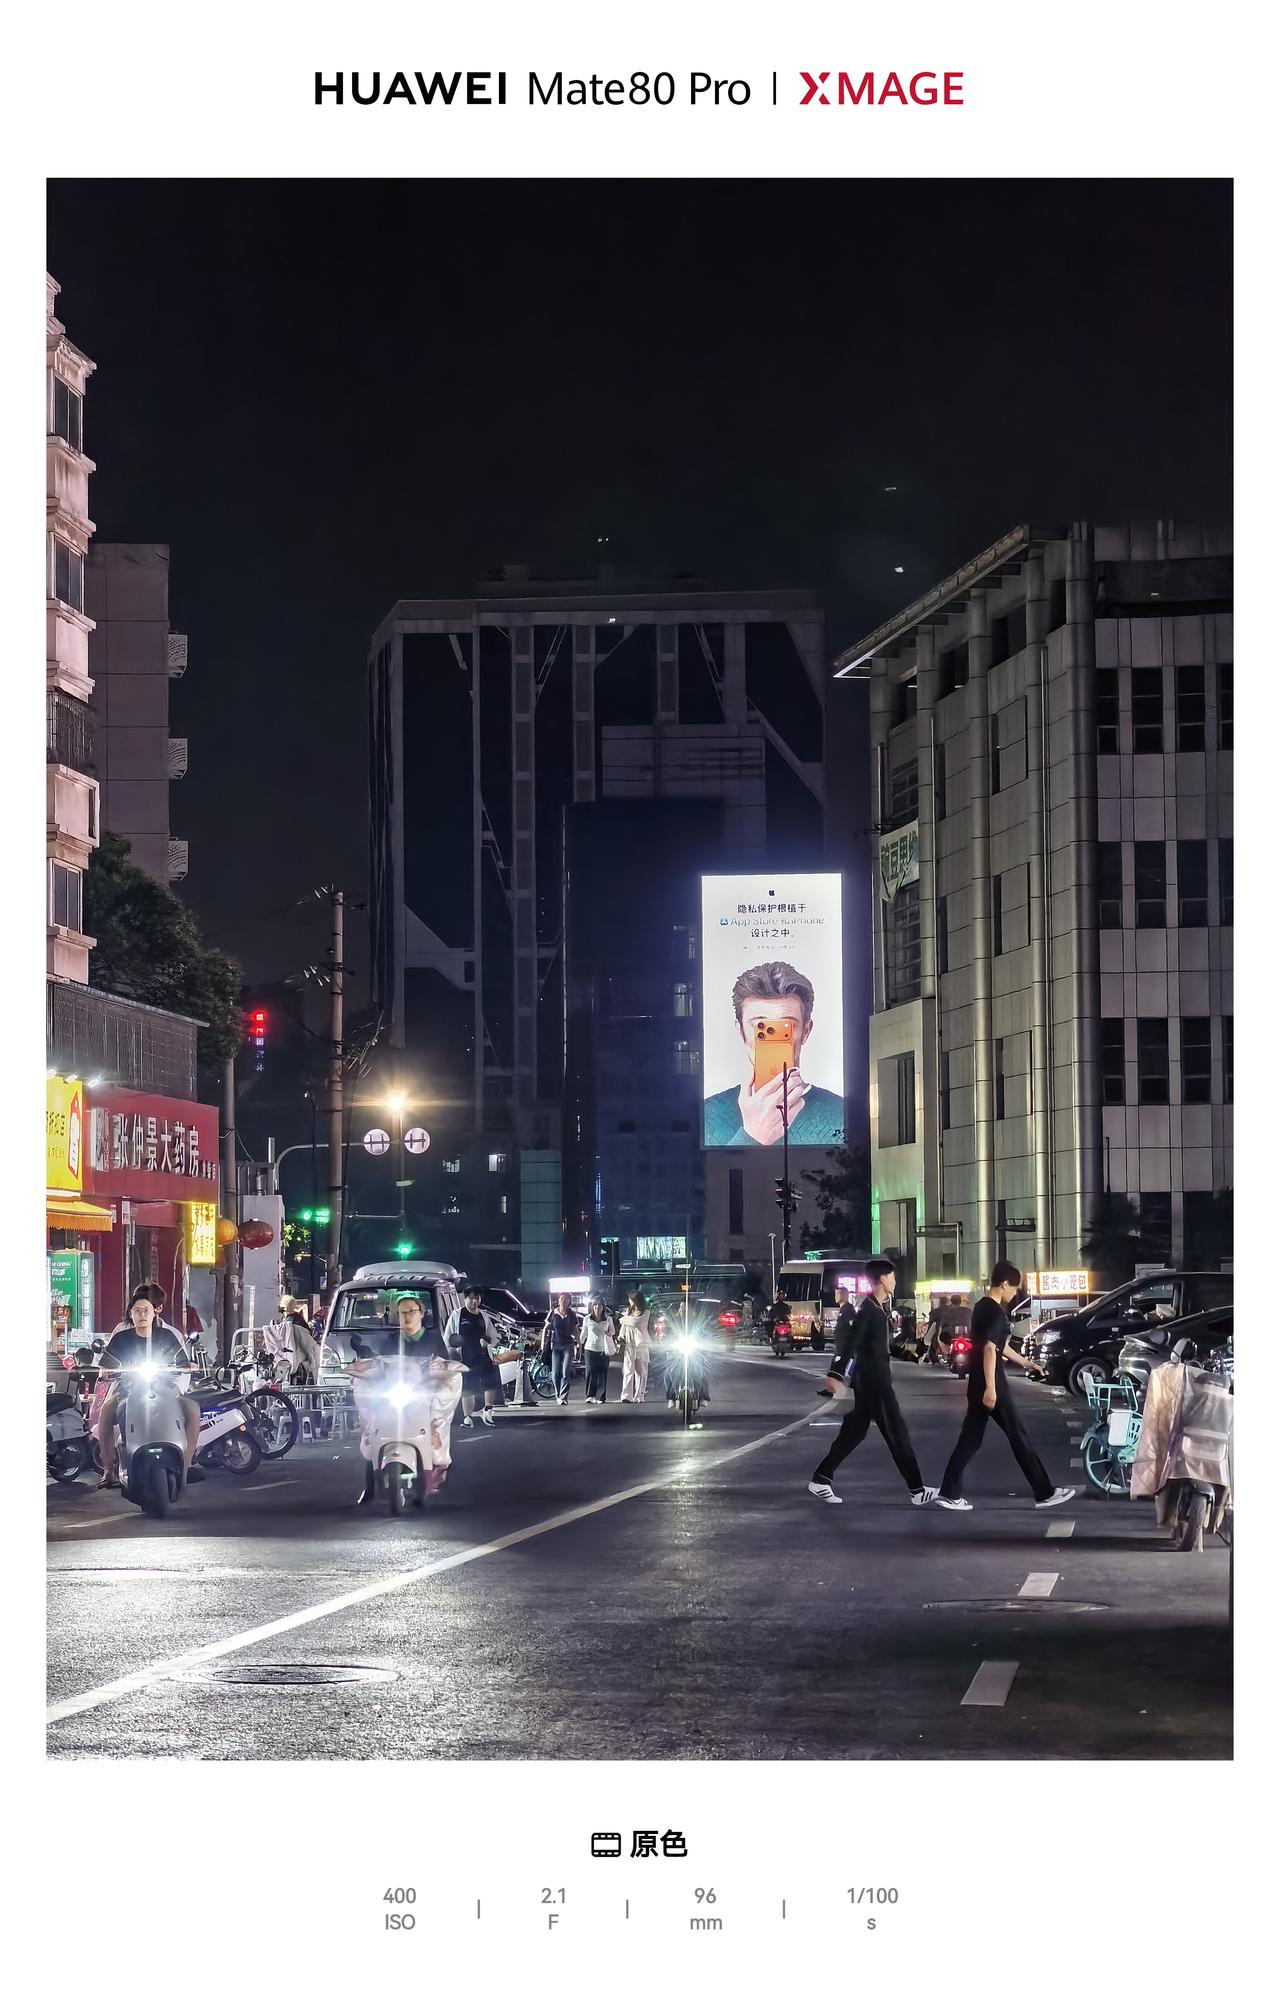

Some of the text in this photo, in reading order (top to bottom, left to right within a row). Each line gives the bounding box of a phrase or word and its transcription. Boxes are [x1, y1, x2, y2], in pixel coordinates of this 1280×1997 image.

[737, 903, 807, 914] 隐私保护根植于
[730, 917, 751, 927] App
[753, 917, 779, 926] Store
[112, 1113, 199, 1177] 张仲景大药房
[1042, 1274, 1087, 1291] 酱肉小笼包
